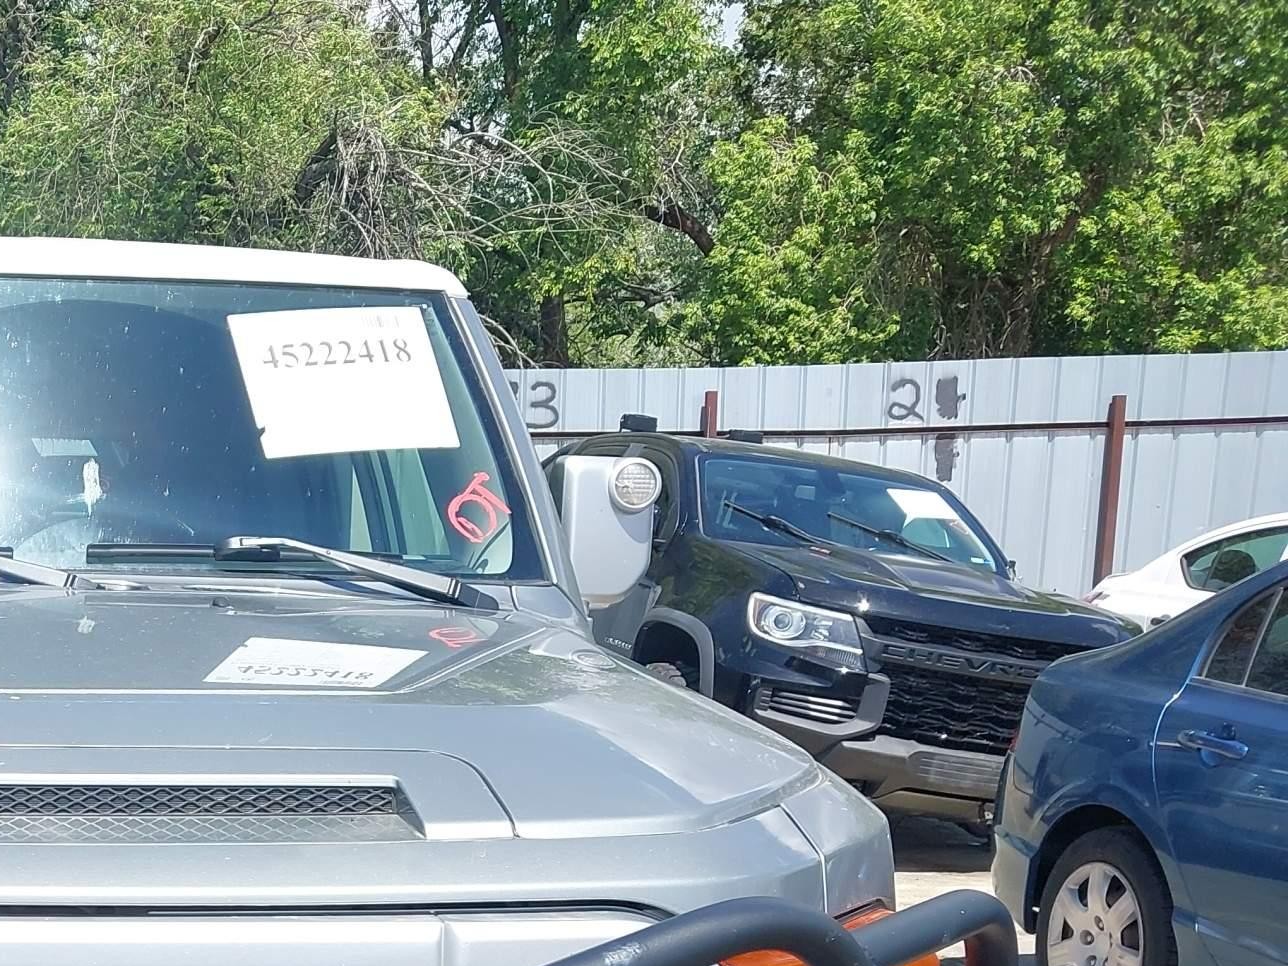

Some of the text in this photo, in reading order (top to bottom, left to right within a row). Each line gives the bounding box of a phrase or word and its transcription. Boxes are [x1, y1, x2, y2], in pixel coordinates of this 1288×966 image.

[262, 338, 412, 368] 45222418
[525, 381, 559, 429] 3
[888, 378, 924, 422] 2
